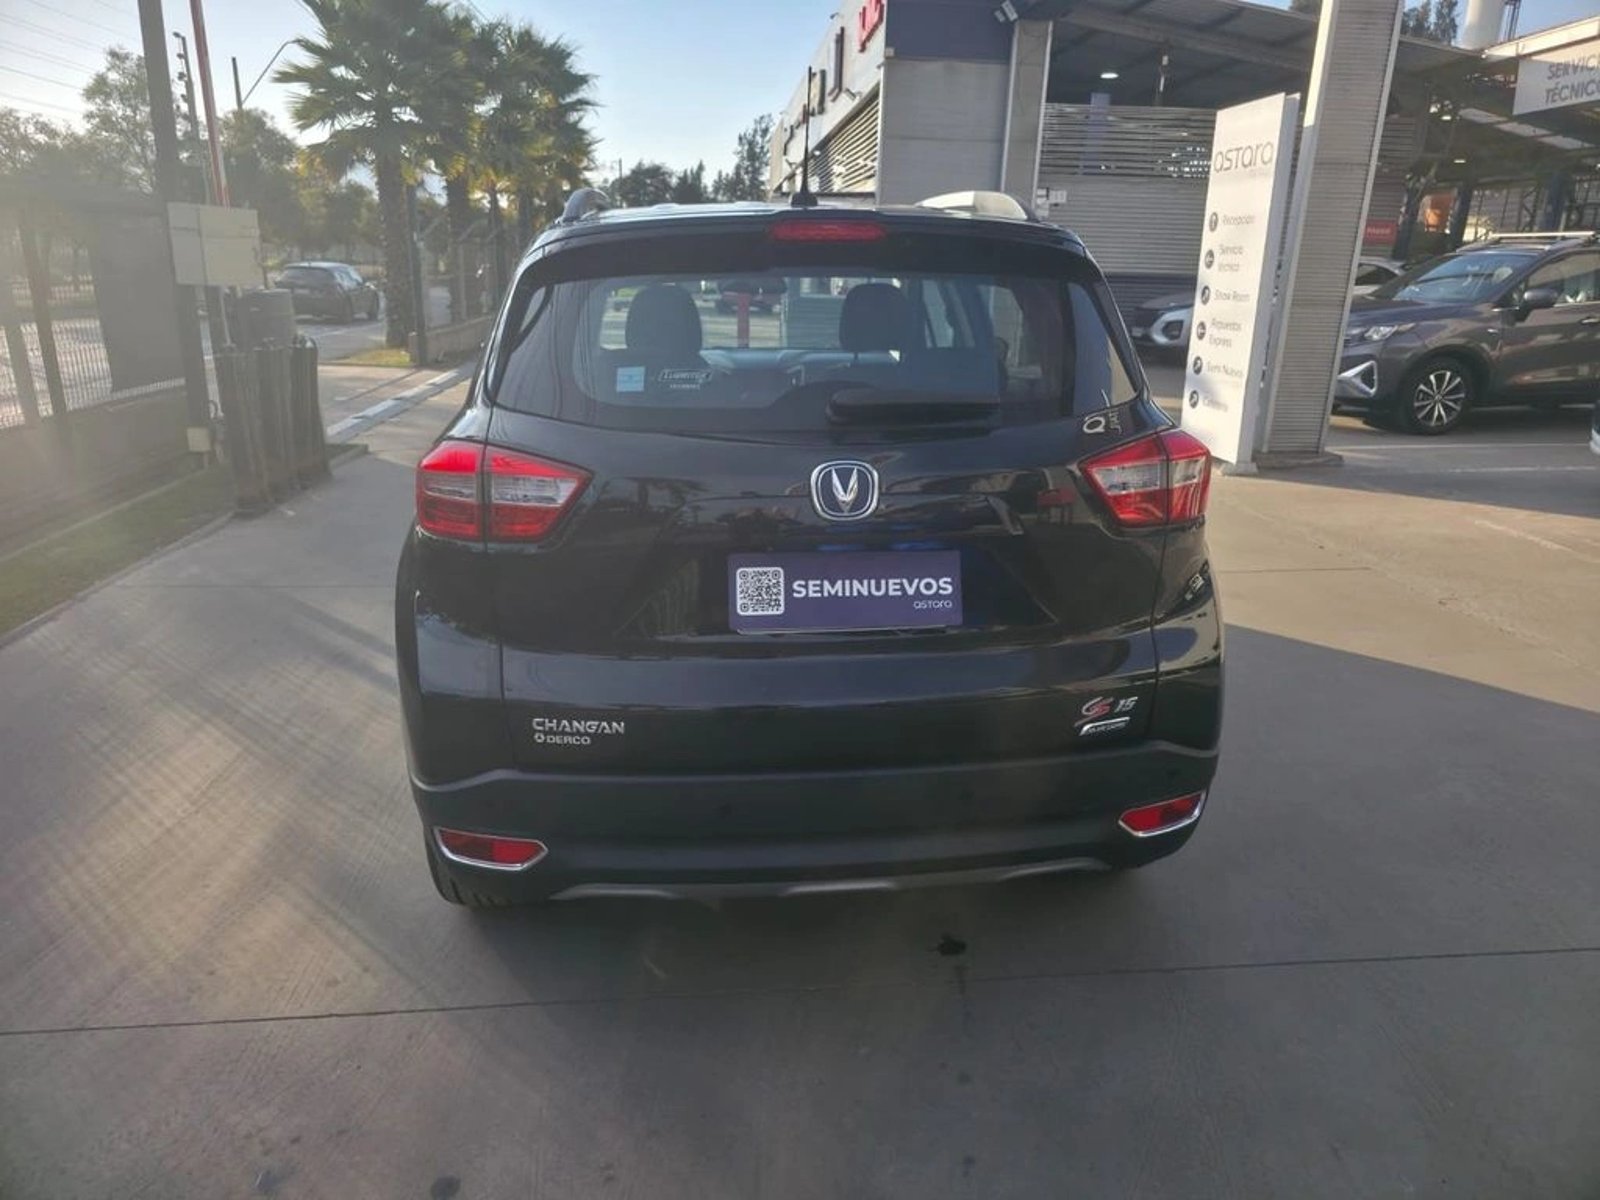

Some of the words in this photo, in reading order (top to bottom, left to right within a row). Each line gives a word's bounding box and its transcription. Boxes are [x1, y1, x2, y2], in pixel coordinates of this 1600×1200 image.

[792, 577, 953, 598] SEMINUEVOS
[1114, 696, 1139, 713] 15
[532, 718, 625, 734] CHANGAN
[546, 735, 591, 745] DERCO
